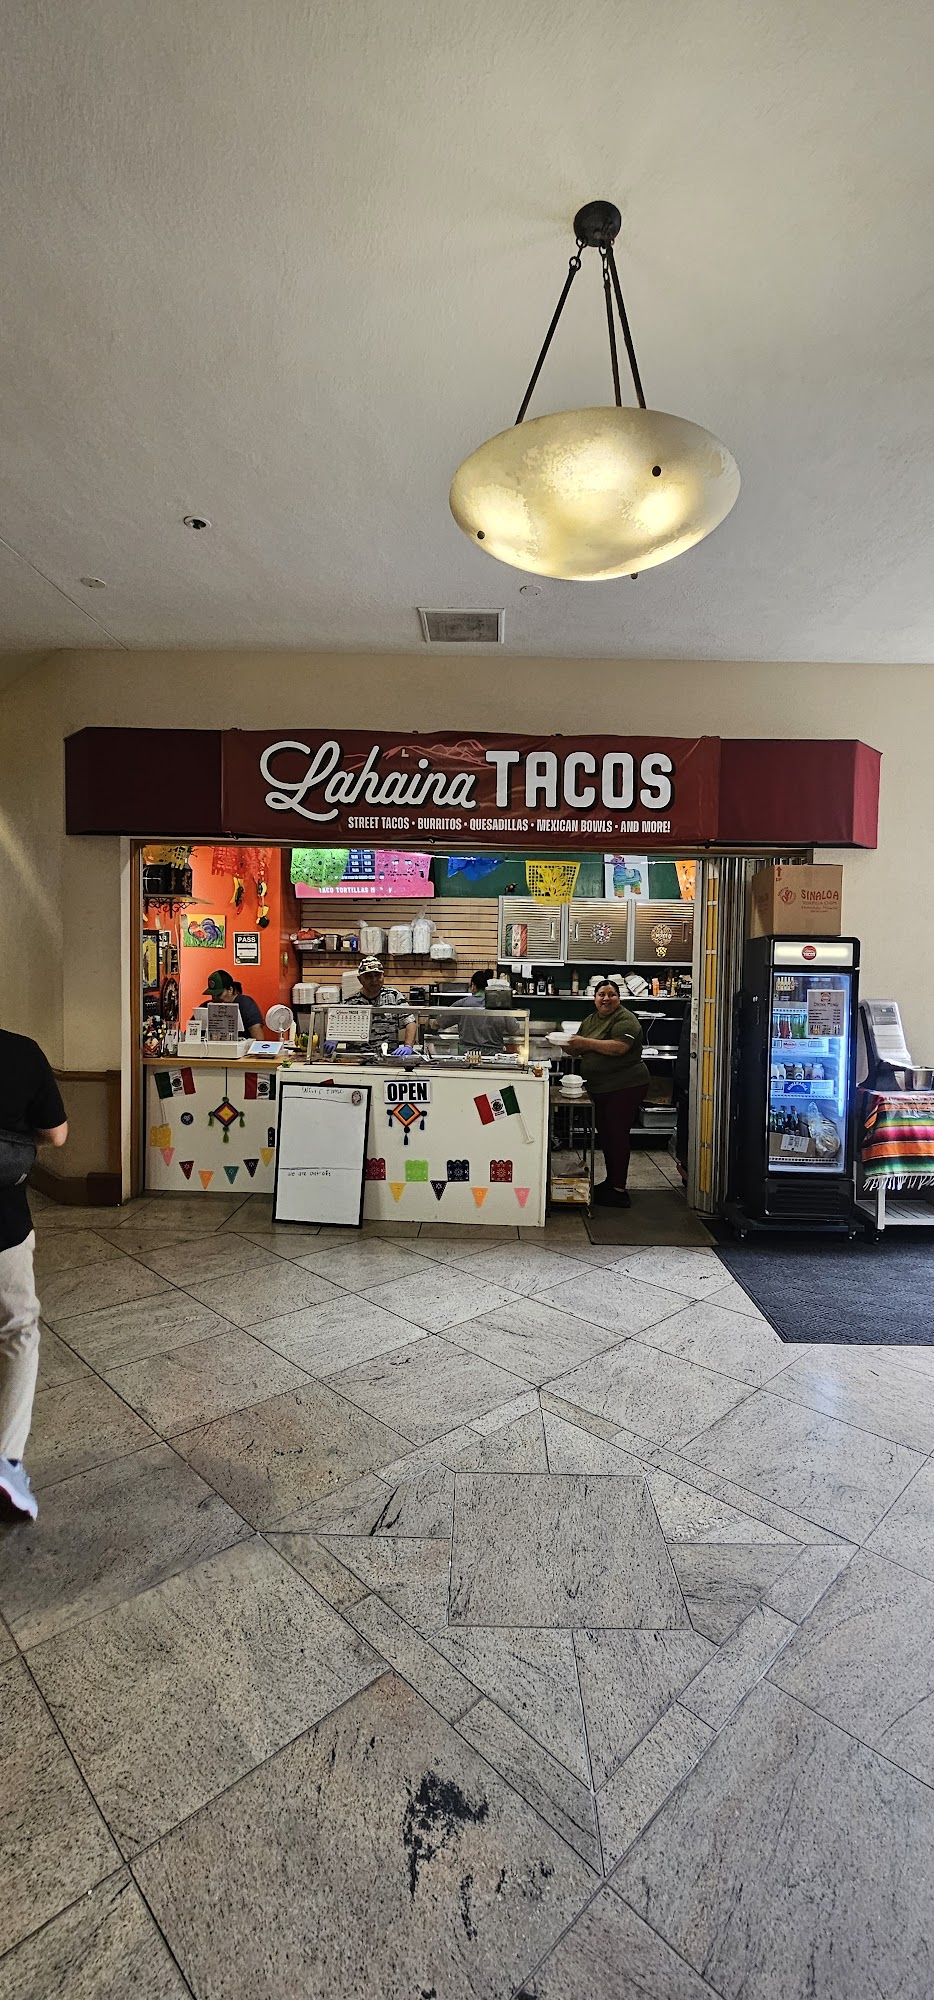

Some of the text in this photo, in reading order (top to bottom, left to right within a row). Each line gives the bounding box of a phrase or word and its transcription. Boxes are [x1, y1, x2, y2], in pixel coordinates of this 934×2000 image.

[260, 740, 673, 822] Lahaina TACOS
[348, 816, 671, 833] STREET TACOS BURRITOS QUESADILLAS MEXICAN BOWLS AND MORE!
[801, 889, 839, 901] SINALOA
[387, 1083, 428, 1102] OPEN
